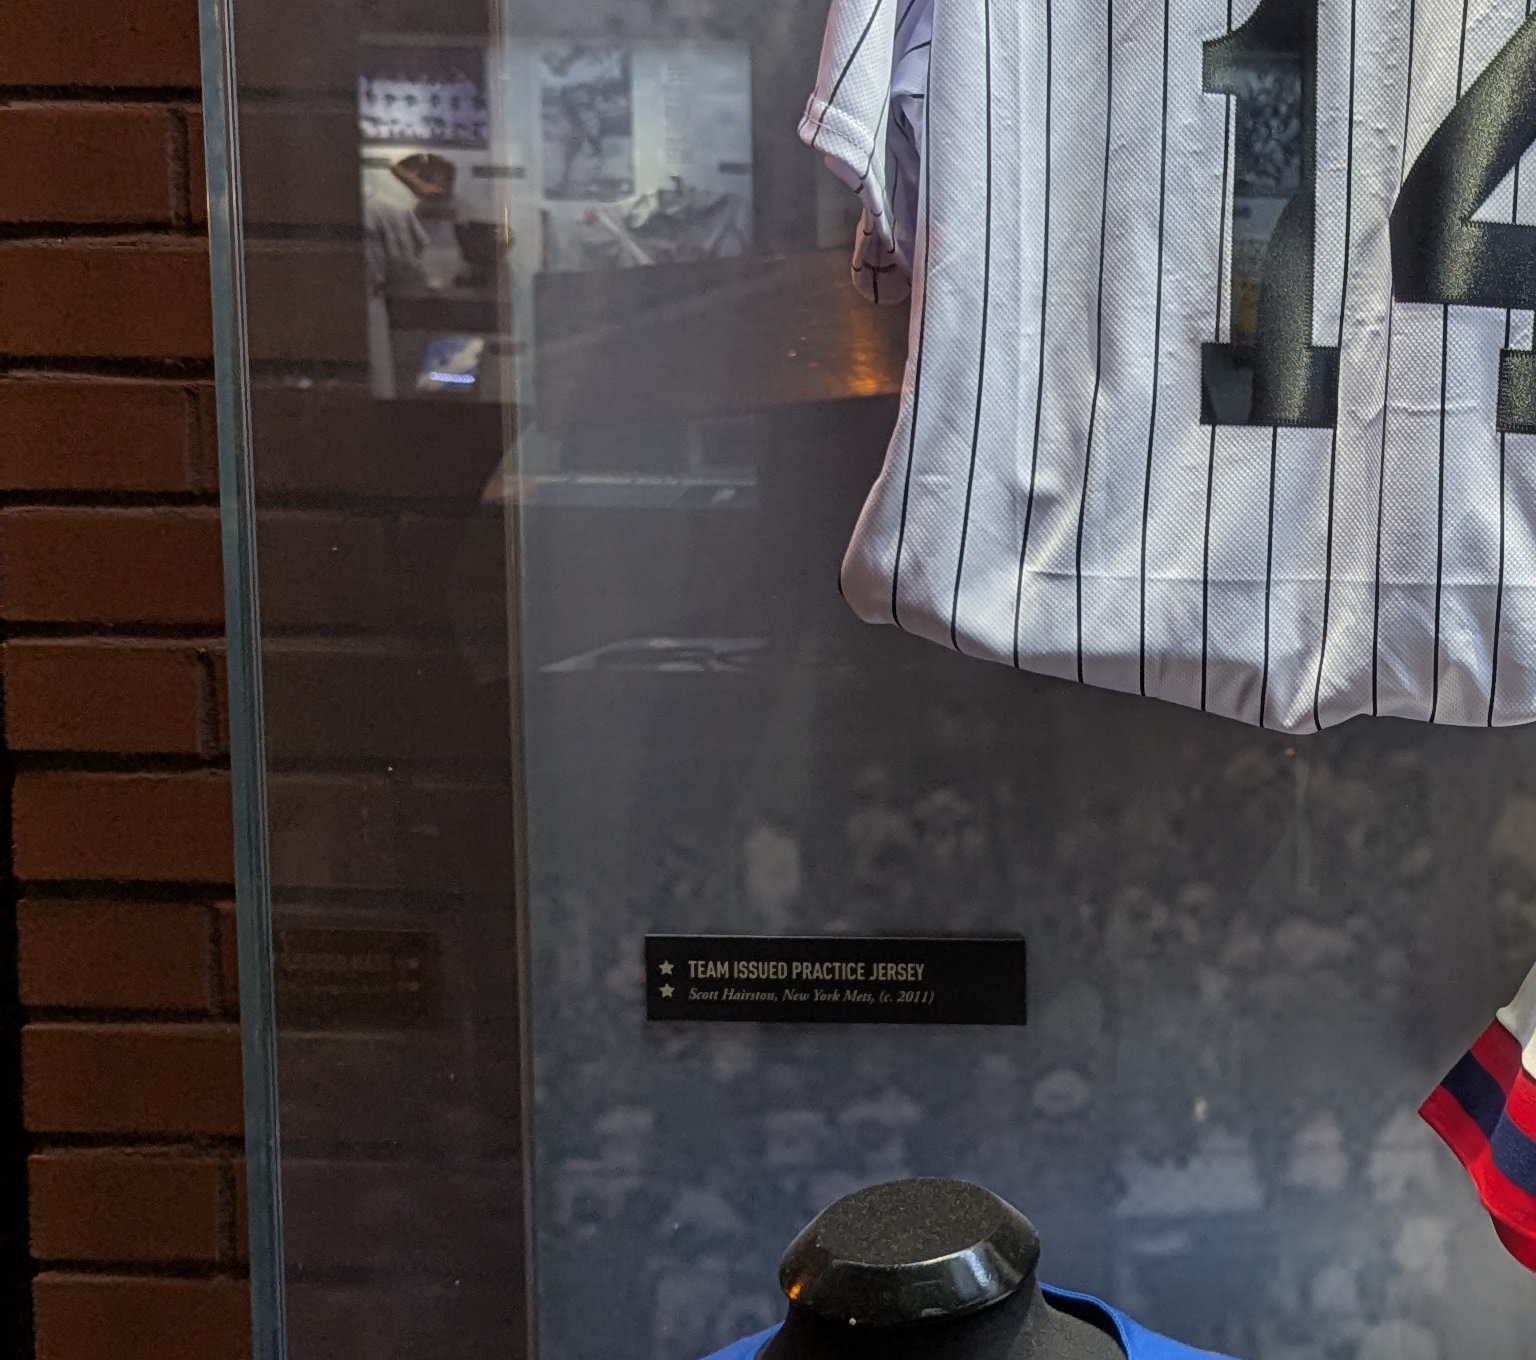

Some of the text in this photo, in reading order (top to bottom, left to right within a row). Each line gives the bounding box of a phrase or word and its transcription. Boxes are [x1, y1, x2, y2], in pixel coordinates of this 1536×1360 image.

[689, 960, 924, 981] TEAM ISSUED PRACTICE JERSEY
[689, 988, 934, 1006] Scott Hairston, New York Mets, (c. 2011)
